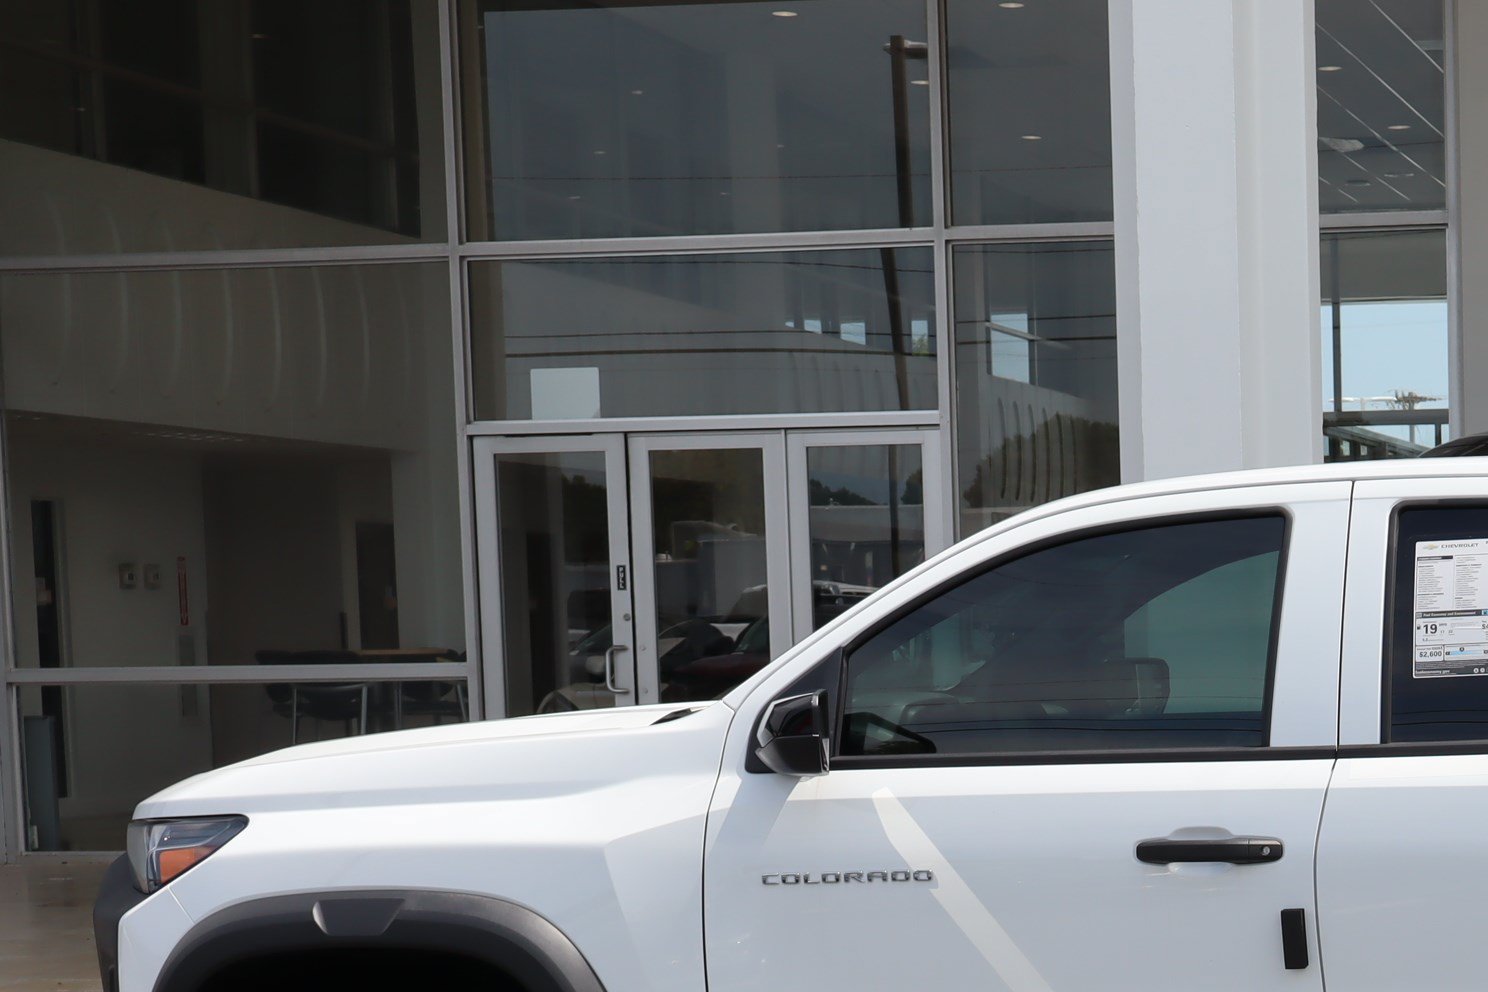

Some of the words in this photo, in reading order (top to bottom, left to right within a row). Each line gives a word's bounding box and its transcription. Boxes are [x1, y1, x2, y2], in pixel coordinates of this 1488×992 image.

[1423, 623, 1438, 634] 19
[1419, 650, 1443, 658] $2,600
[761, 869, 933, 886] COLORADO
